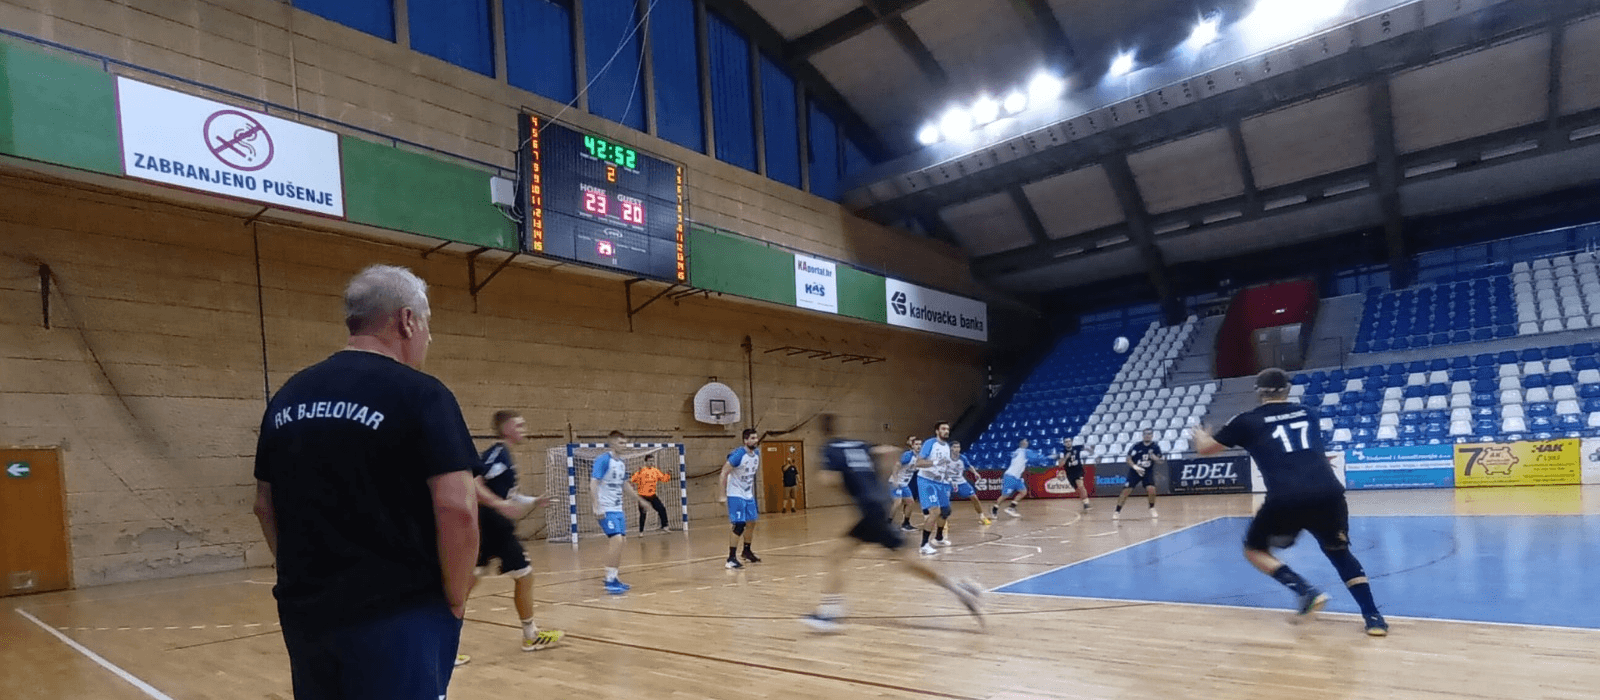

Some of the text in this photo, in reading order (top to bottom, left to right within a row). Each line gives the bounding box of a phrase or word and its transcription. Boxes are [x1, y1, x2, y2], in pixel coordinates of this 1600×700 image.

[533, 151, 539, 160] 7
[583, 135, 636, 169] 42:52
[134, 152, 334, 207] ZABRANJENO PUŠENJE
[606, 165, 616, 182] 2
[580, 183, 606, 195] HOME
[585, 192, 607, 215] 23
[616, 193, 643, 206] GUEST
[622, 202, 644, 225] 20
[797, 259, 832, 277] KAportal.hr
[909, 302, 984, 332] karlovačka banka
[274, 401, 385, 430] RK BJELOVAR
[1272, 420, 1309, 453] 17
[1181, 462, 1238, 480] EDEL
[1181, 478, 1237, 487] SPORT
